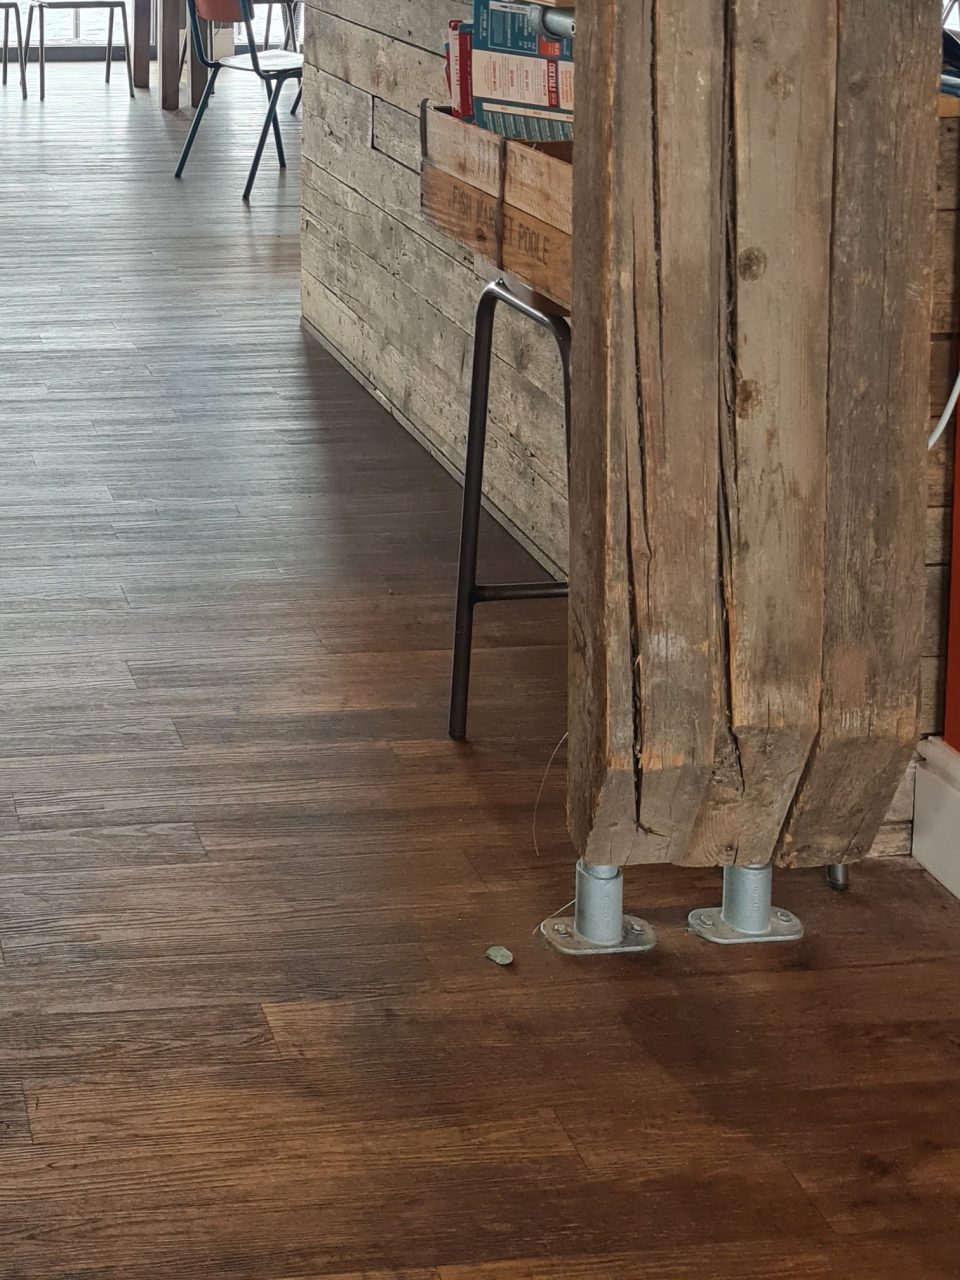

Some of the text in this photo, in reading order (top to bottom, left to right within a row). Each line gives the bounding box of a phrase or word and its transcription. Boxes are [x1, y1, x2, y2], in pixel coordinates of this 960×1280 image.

[548, 62, 557, 92] COCKTAILS
[452, 184, 473, 222] FISH
[518, 222, 550, 267] POOLE
